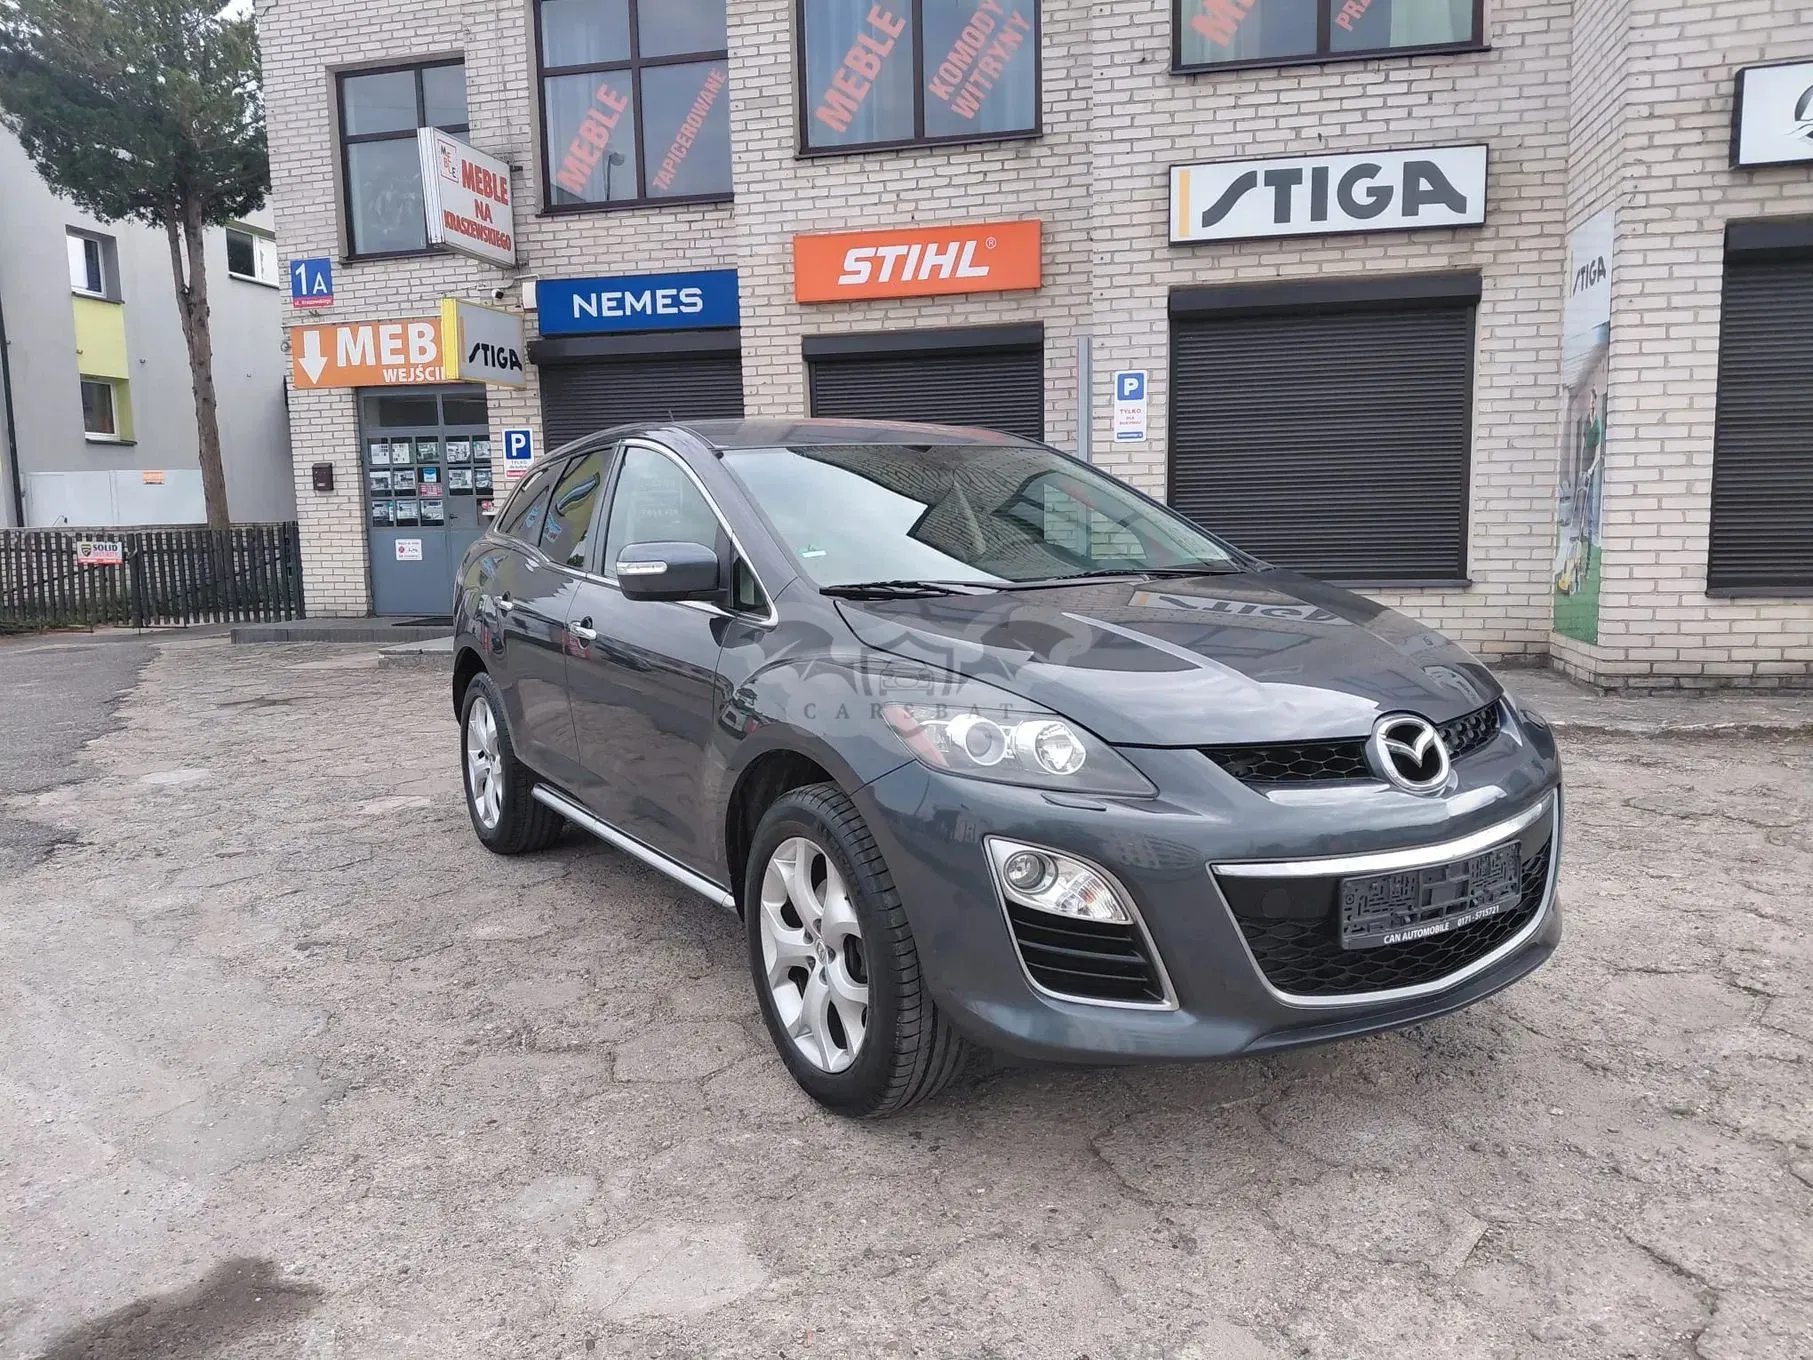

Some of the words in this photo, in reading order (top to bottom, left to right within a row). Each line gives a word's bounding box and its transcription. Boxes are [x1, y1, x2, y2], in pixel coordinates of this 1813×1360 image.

[815, 3, 907, 134] MEBLE
[928, 0, 1004, 101] KOMODY
[951, 11, 1031, 120] WITRYNY
[556, 82, 629, 194] MEBLE
[652, 67, 728, 191] TAPICEROWANE
[461, 159, 509, 206] MEBLE
[1201, 160, 1468, 228] STIGA
[443, 210, 512, 252] KRASZEWSKIEGO
[474, 198, 493, 224] NA
[837, 240, 990, 286] STIHL
[1572, 255, 1607, 297] STIGA
[572, 287, 704, 318] NEMES
[468, 342, 523, 372] STIGA
[1123, 377, 1139, 397] P
[511, 433, 526, 457] P
[1383, 933, 1401, 944] CAN
[1402, 922, 1450, 941] AUTOMOBILE
